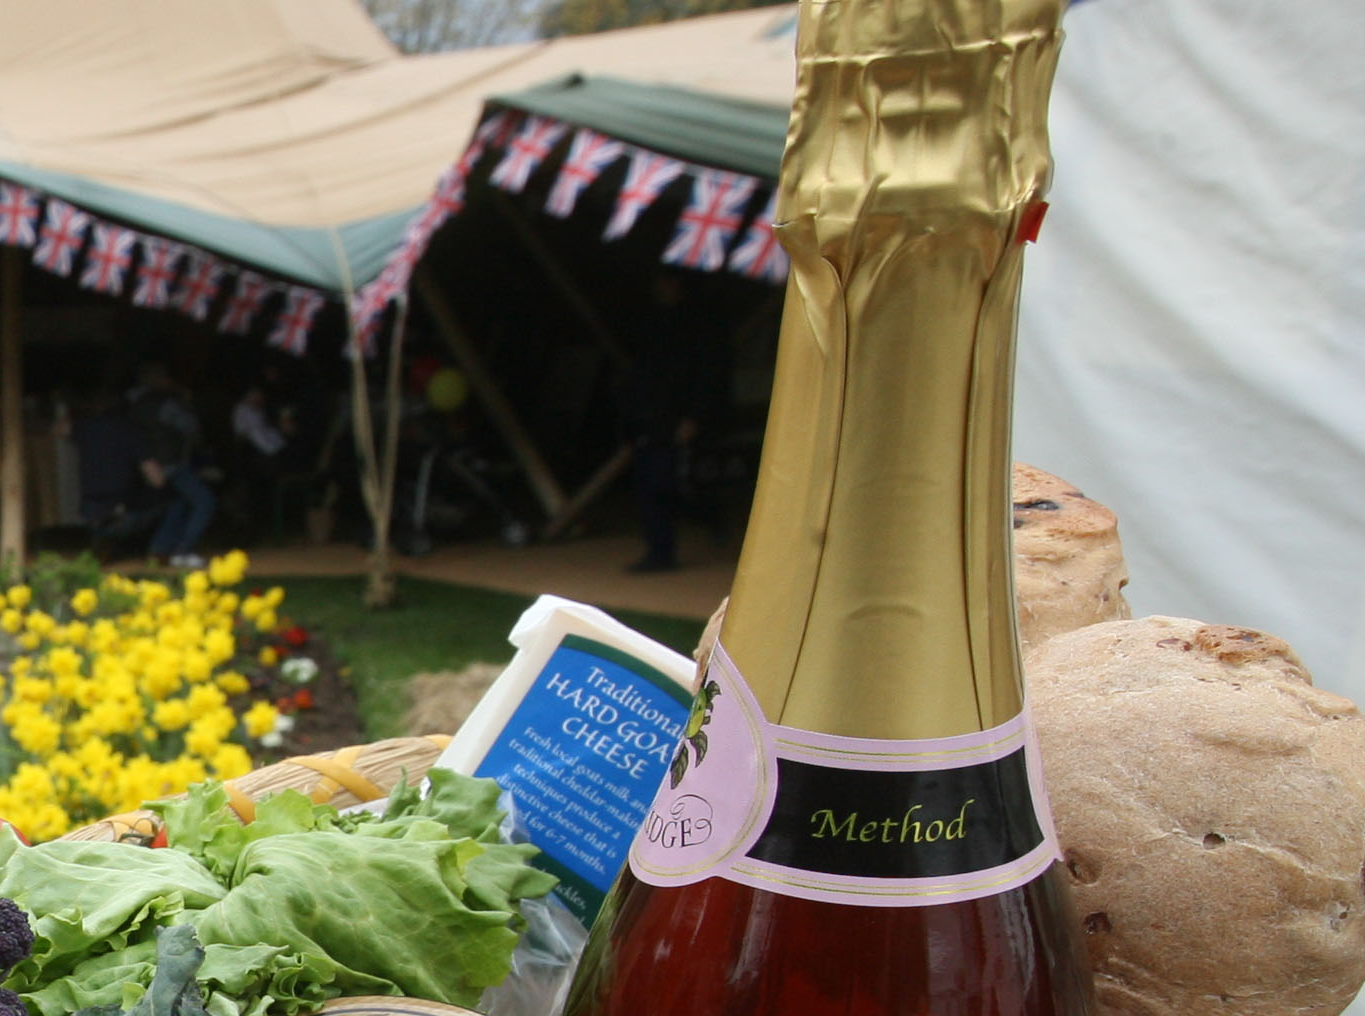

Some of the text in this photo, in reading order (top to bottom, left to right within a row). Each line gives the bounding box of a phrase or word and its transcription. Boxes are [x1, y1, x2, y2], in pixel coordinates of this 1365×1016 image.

[545, 672, 671, 765] HARD GOA
[585, 665, 686, 741] Traditional
[508, 737, 566, 779] traditional
[523, 726, 553, 751] Fresh
[553, 743, 580, 767] local
[562, 716, 650, 780] CHEESE
[496, 773, 549, 812] distinctive
[547, 809, 585, 837] cheese
[582, 832, 609, 853] that
[513, 763, 568, 804] techniques
[563, 800, 614, 834] produce
[810, 799, 975, 844] Method
